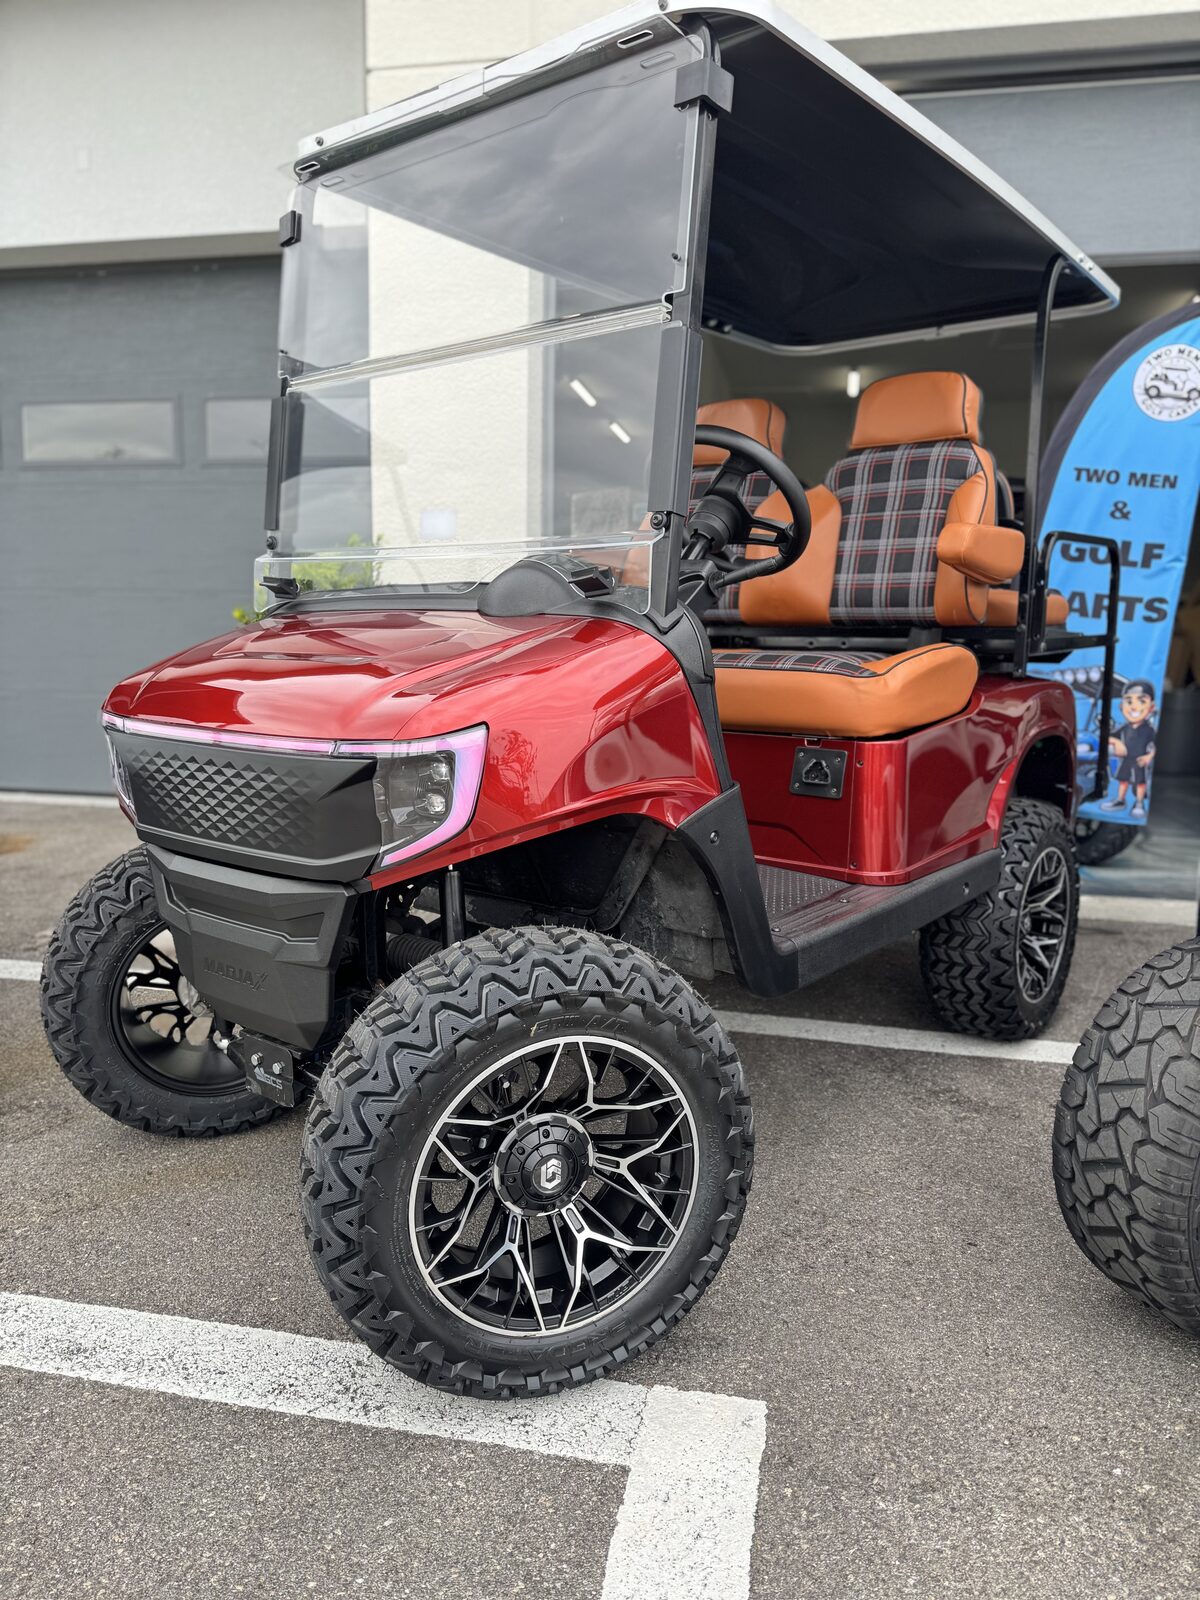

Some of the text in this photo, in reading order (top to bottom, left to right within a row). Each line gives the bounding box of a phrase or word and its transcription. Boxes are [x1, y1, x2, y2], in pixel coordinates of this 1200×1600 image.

[1145, 349, 1172, 366] TWO
[1073, 467, 1178, 489] TWO MEN
[1109, 500, 1131, 520] &
[1060, 539, 1166, 569] GOLF
[1050, 590, 1169, 623] ARTS
